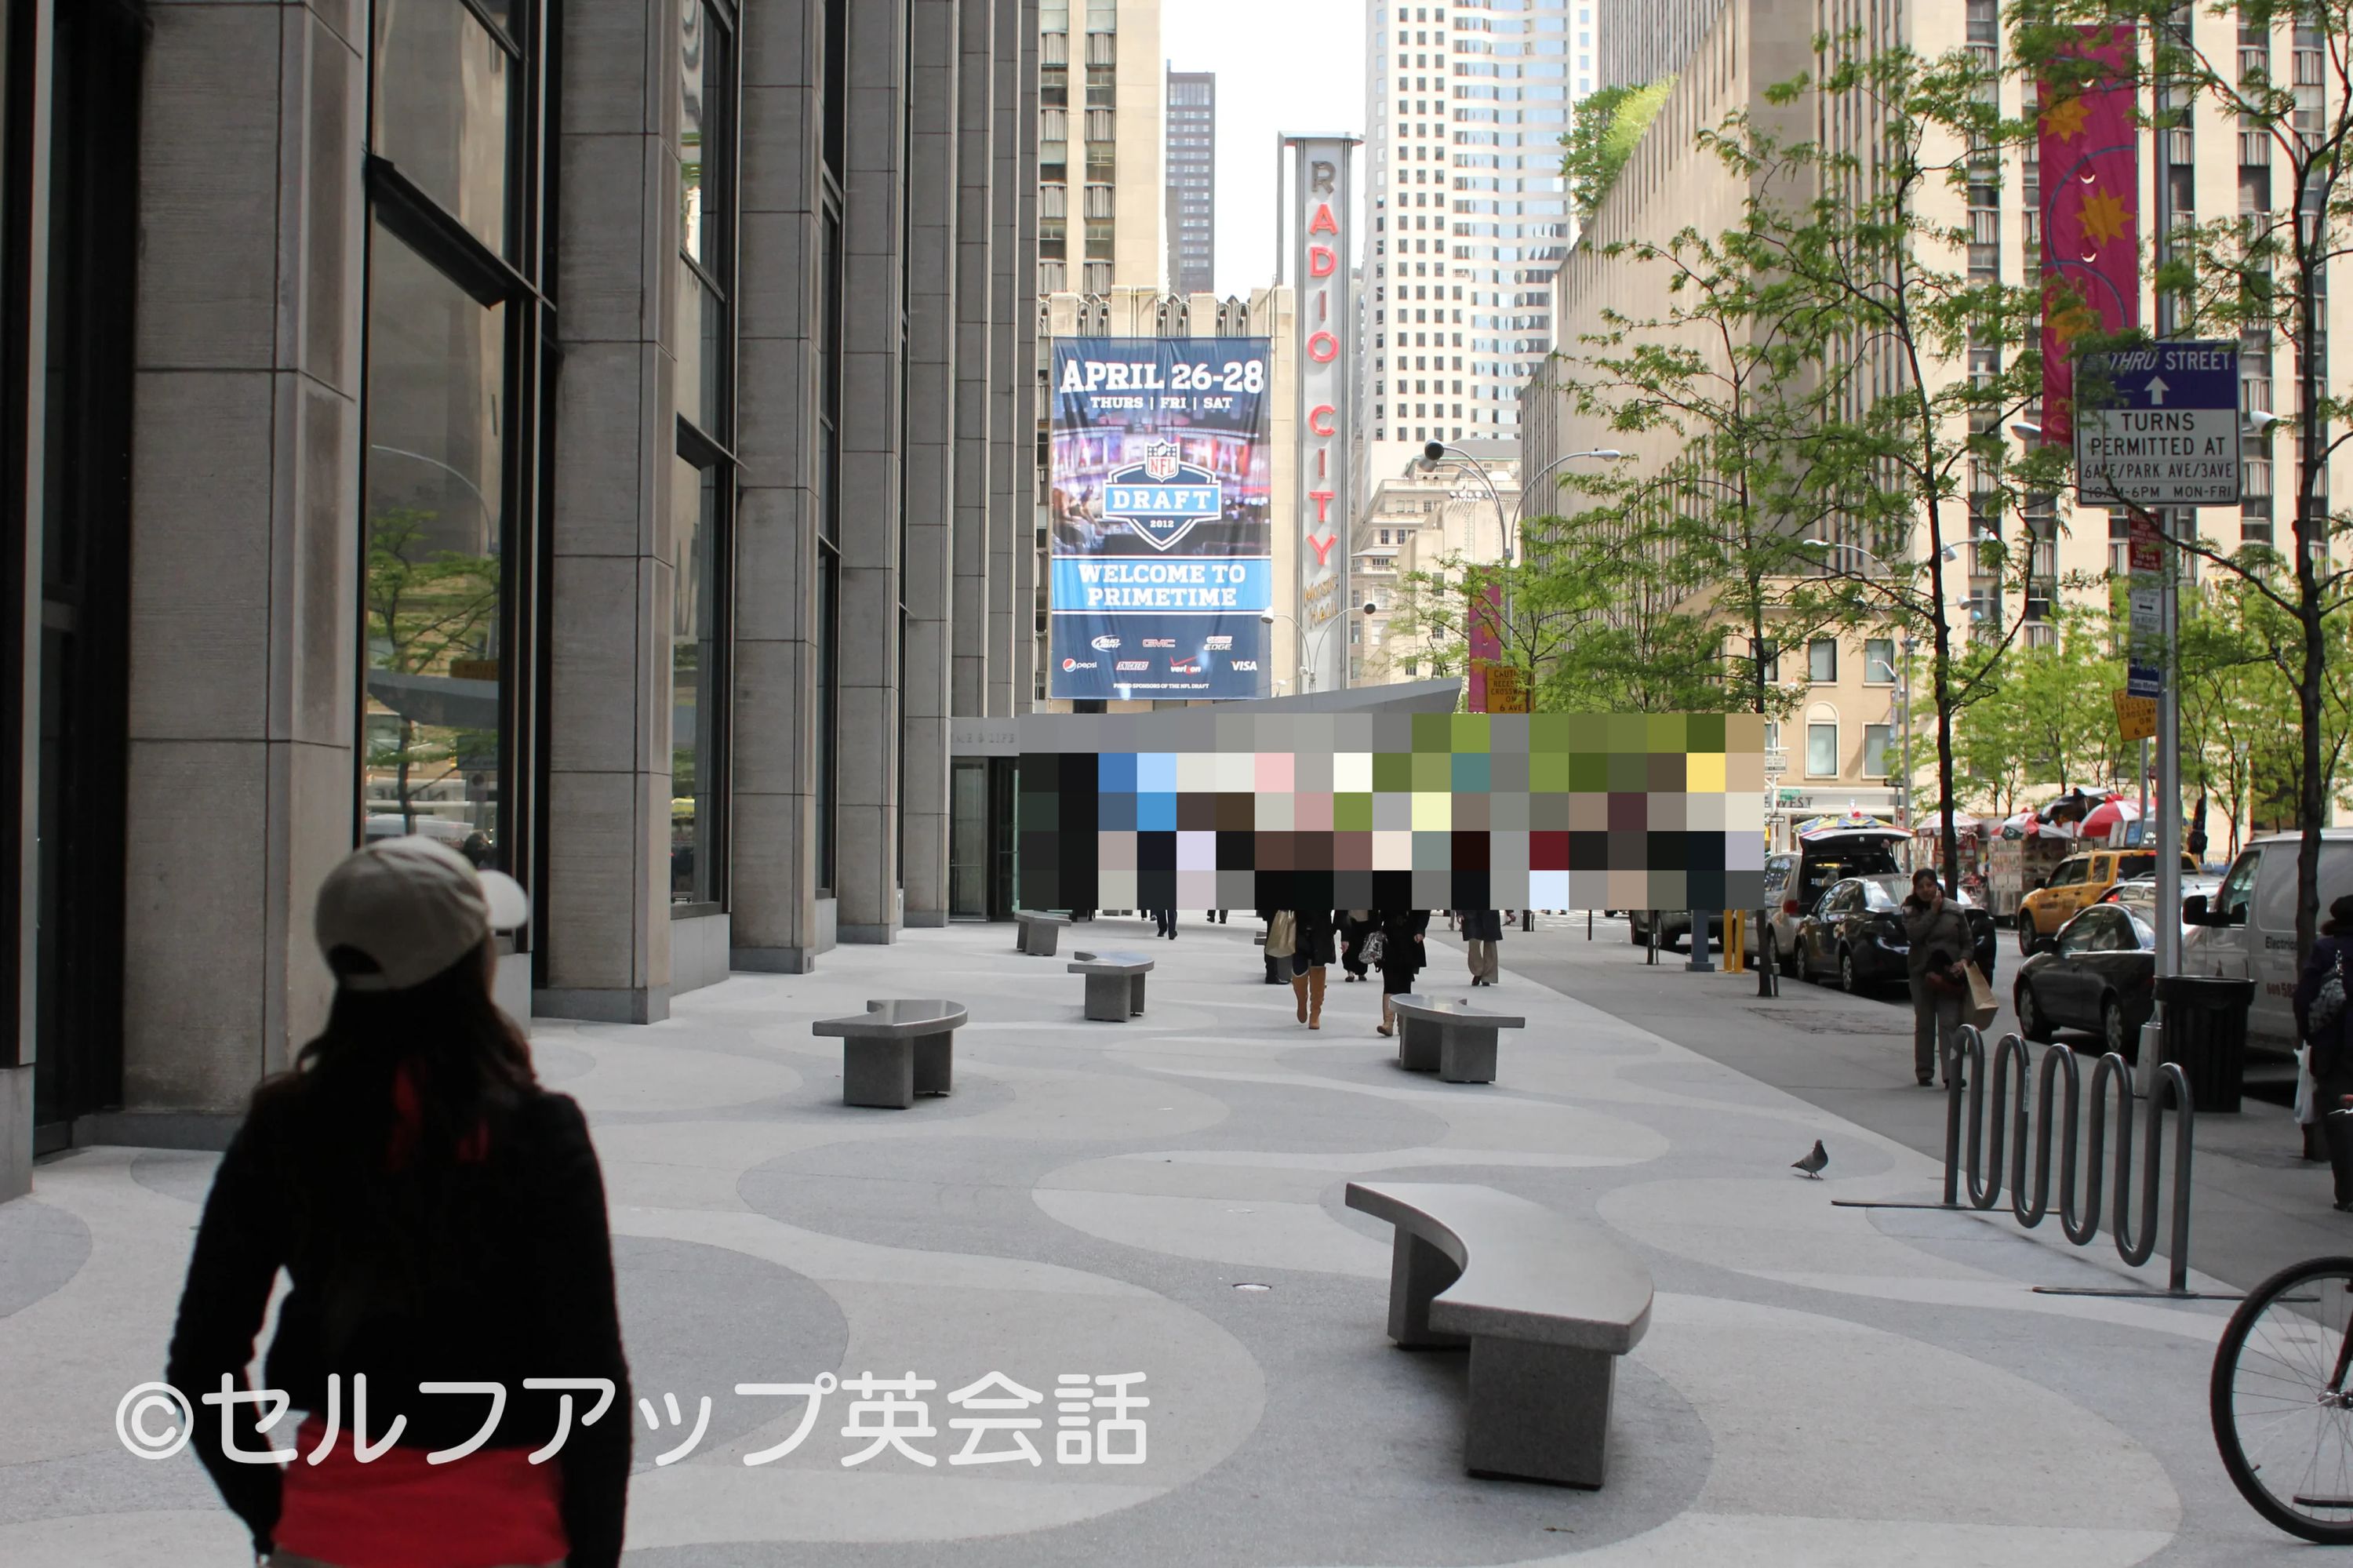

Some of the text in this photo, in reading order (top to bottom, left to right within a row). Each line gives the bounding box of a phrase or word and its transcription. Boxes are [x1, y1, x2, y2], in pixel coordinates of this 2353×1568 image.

[1307, 160, 1340, 566] RADIO CITY
[2110, 351, 2231, 370] THRU STREET
[1060, 359, 1264, 393] APRIL 26-28
[1090, 397, 1232, 409] THURS FRI SAT
[2121, 413, 2195, 431] TURNS
[2090, 437, 2225, 456] PERMITTED AT
[1151, 458, 1174, 475] NFL
[2168, 463, 2232, 478] AVE/3AVE
[1113, 490, 1211, 509] DRAFT
[2173, 486, 2231, 498] MON-FRI
[1078, 564, 1246, 584] WELCOME TO
[1088, 588, 1237, 606] PRIMETIME
[1143, 639, 1176, 648] GMC
[1077, 661, 1097, 670] pepsi
[1170, 665, 1202, 675] verizon
[1231, 660, 1258, 671] VISA
[1494, 670, 1520, 678] CAUTI
[2121, 708, 2156, 720] CROSSWA
